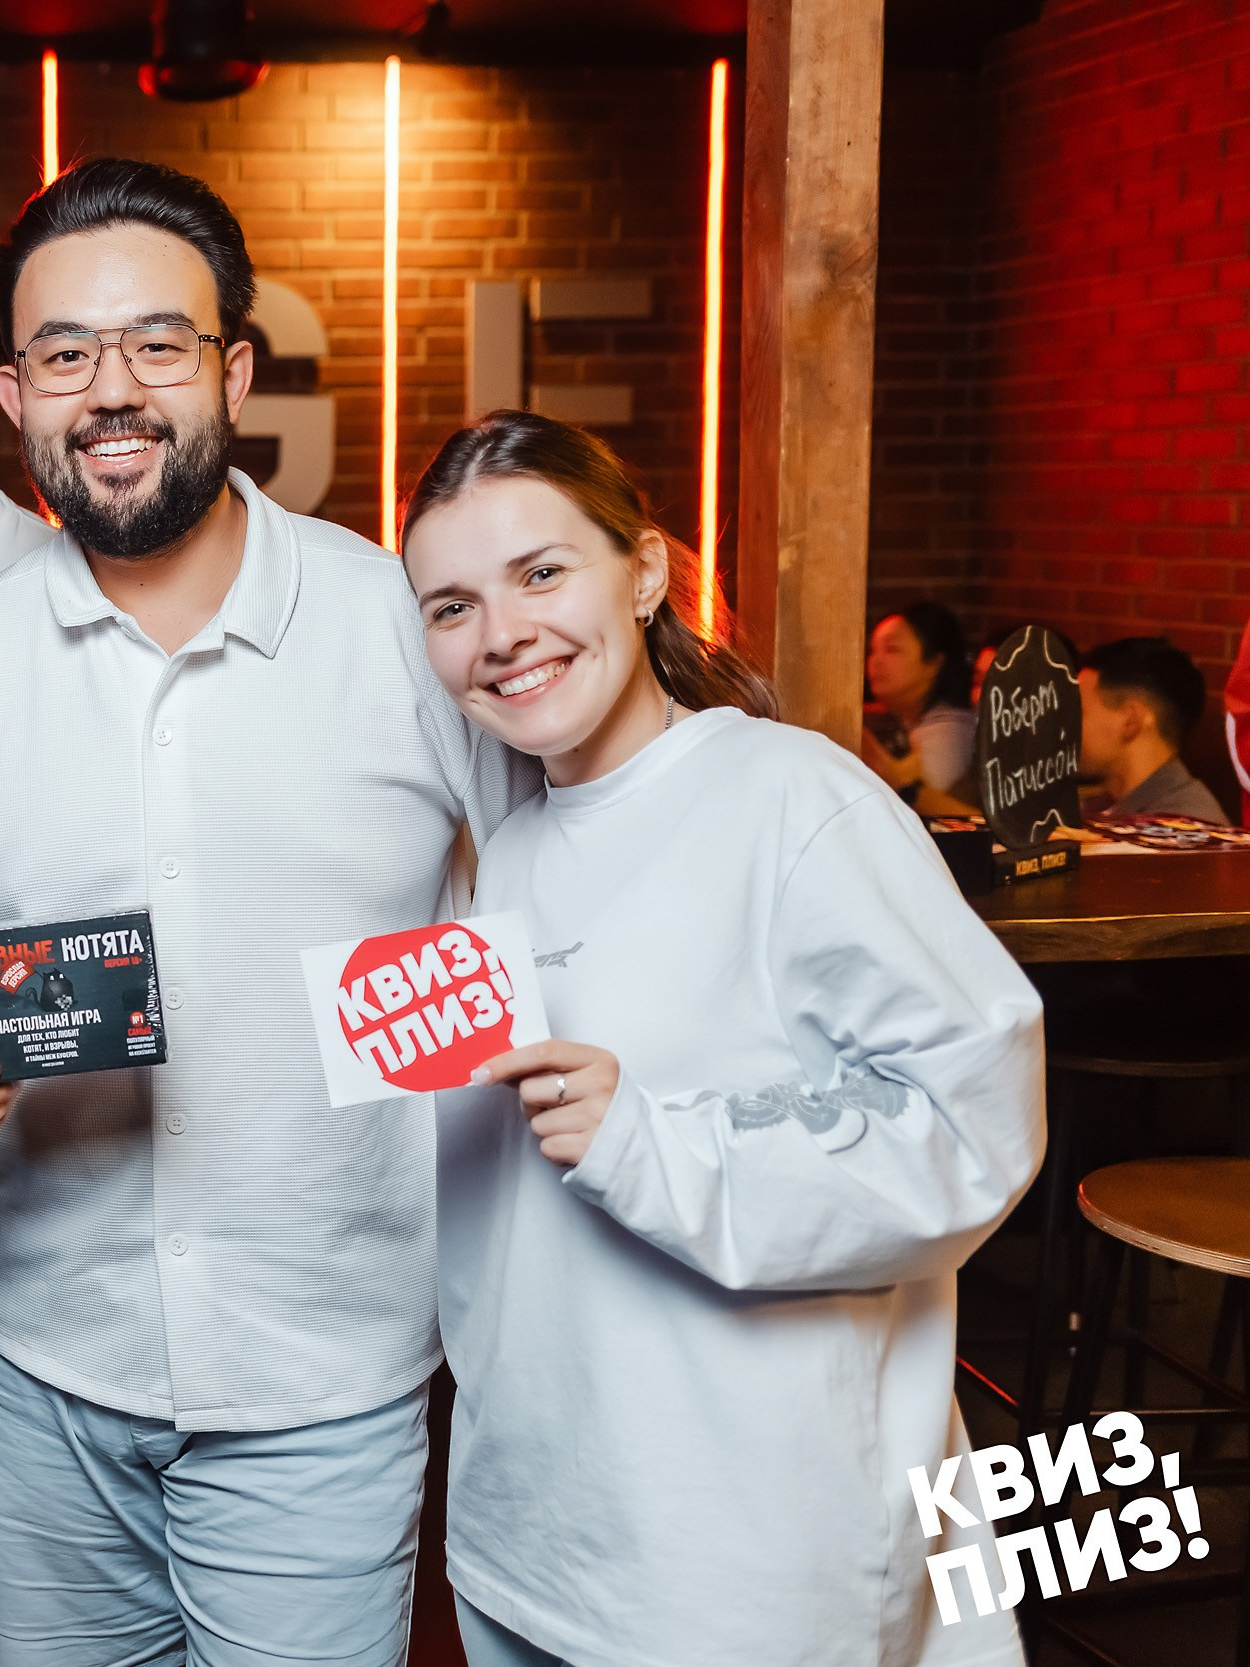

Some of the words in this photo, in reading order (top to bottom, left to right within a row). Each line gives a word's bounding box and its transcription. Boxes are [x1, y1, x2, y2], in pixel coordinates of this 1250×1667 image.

[991, 681, 1058, 742] Роберт
[61, 930, 144, 962] КОТЯТА
[338, 930, 502, 1031] КВИЗ,
[70, 1009, 101, 1026] ИГРА
[352, 970, 516, 1078] ПЛИЗ!
[17, 1034, 31, 1044] ДЛЯ
[31, 1032, 45, 1041] ТЕХ,
[45, 1031, 57, 1040] КТО
[58, 1029, 79, 1038] ЛЮБИТ
[23, 1044, 44, 1053] КОТЯТ,
[44, 1043, 49, 1051] И
